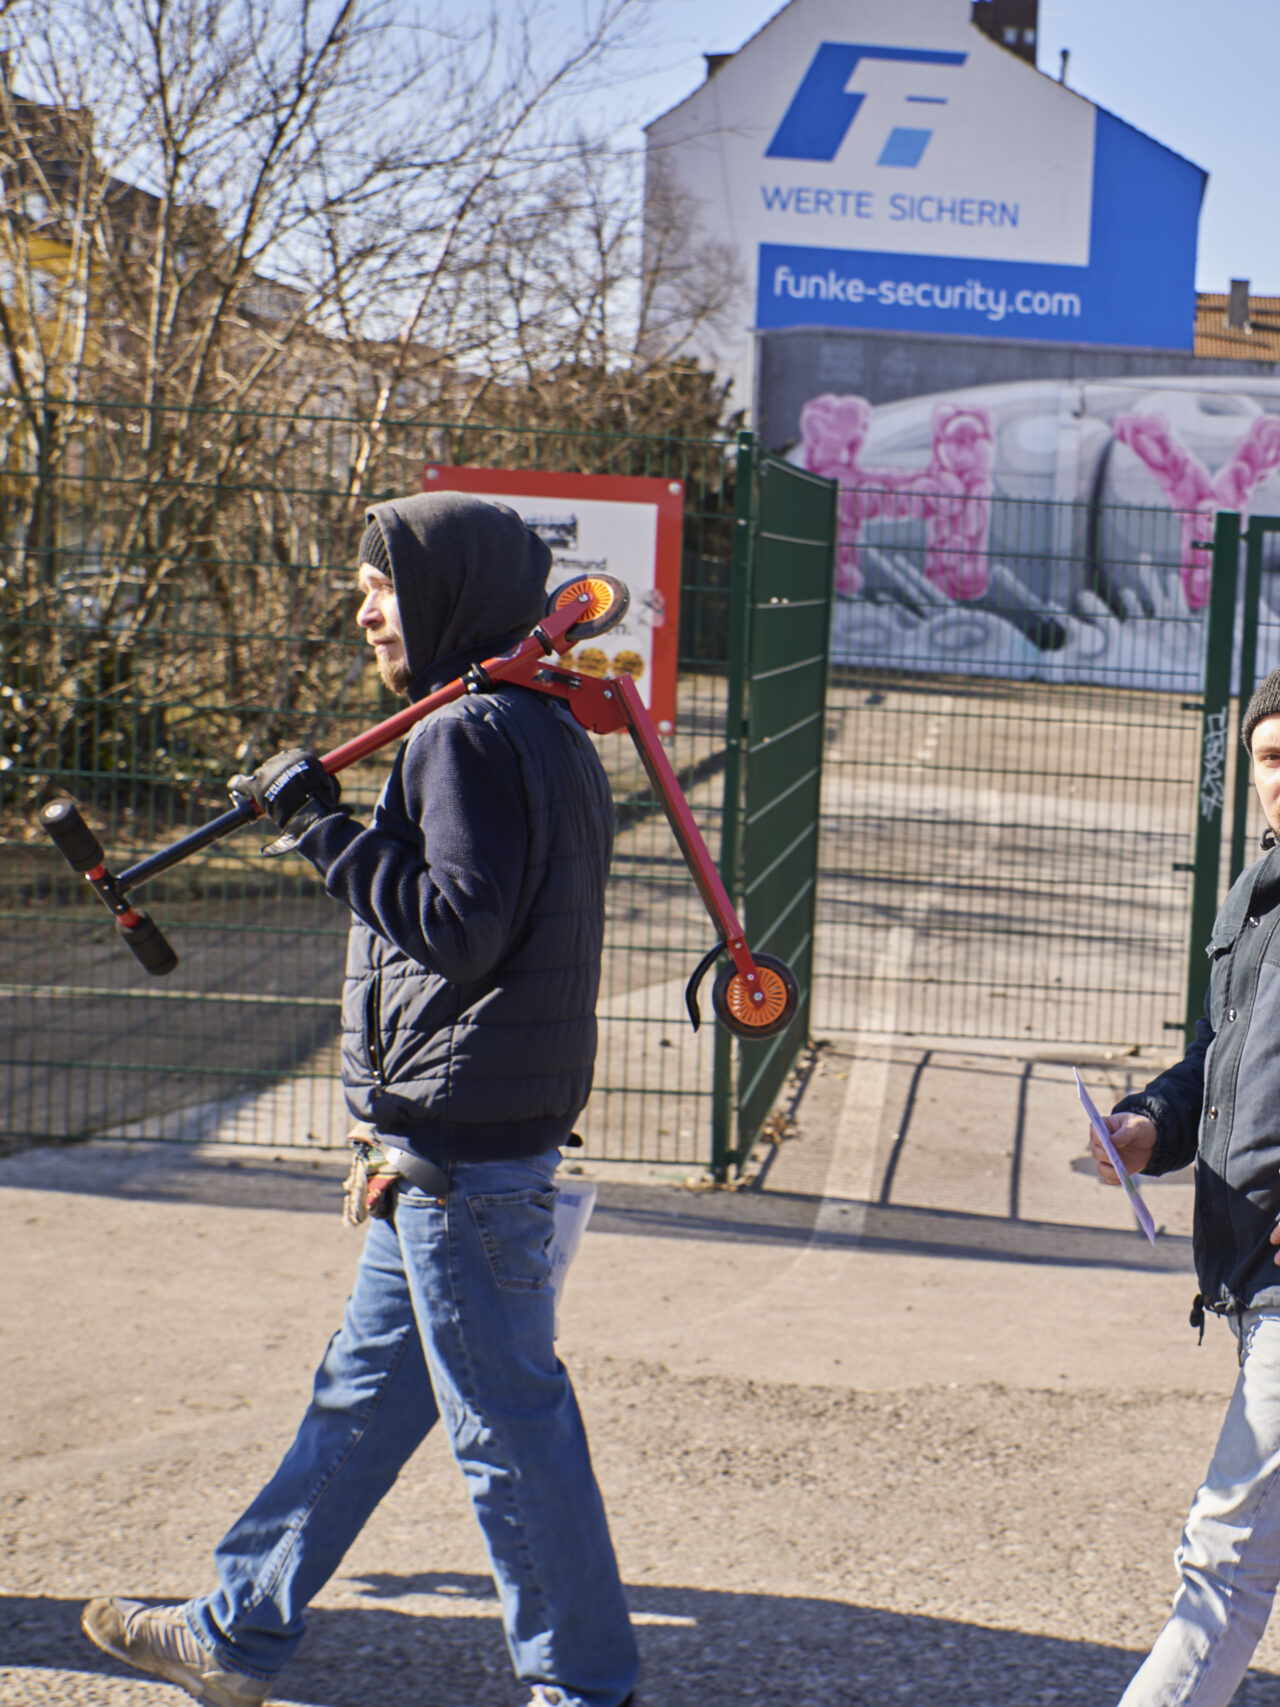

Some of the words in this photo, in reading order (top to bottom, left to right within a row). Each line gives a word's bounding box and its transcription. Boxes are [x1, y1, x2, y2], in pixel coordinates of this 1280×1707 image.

[760, 185, 874, 219] WERTE
[889, 193, 1020, 228] SICHERN
[773, 264, 1081, 321] funke-security.com
